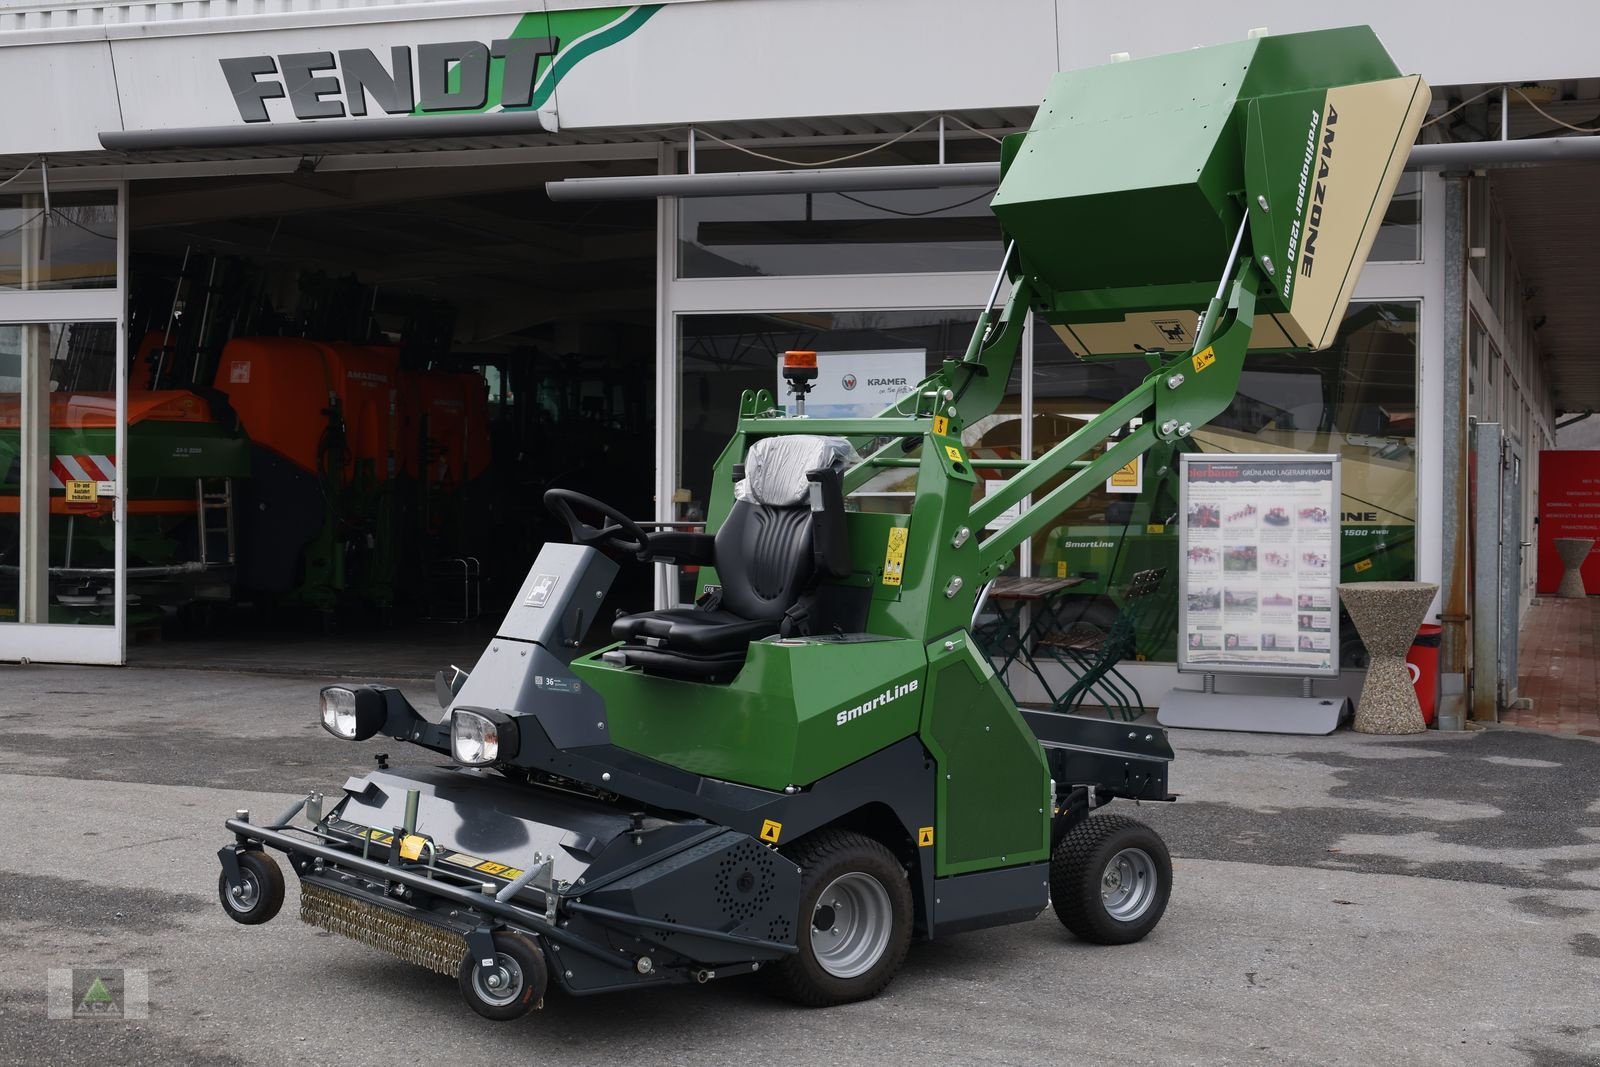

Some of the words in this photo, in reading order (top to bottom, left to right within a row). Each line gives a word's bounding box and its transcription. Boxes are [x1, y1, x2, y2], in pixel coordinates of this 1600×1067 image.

[218, 36, 560, 123] FENDT
[1301, 103, 1338, 279] AMAZONE
[1287, 217, 1302, 262] 1250
[867, 377, 907, 386] KRAMER
[1242, 467, 1277, 476] GRÜNLAND
[545, 677, 554, 686] 36
[836, 679, 918, 726] SmartLine
